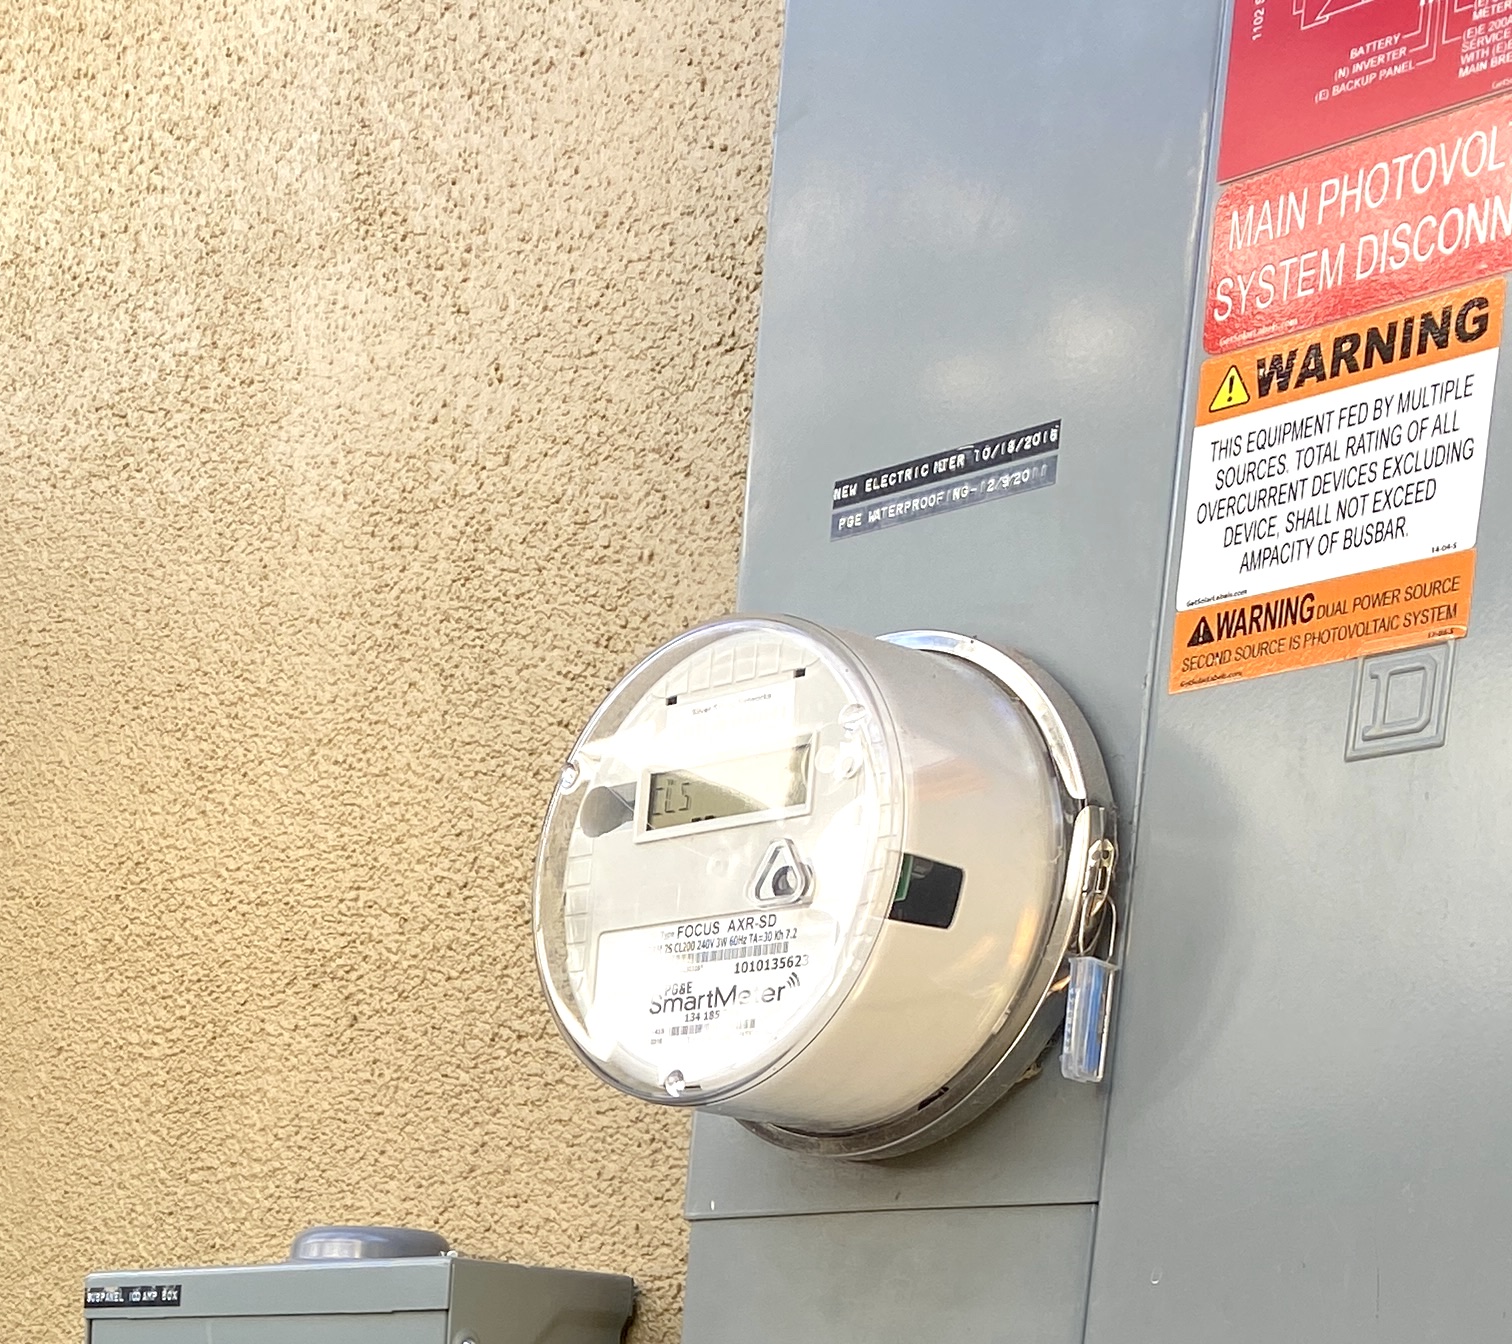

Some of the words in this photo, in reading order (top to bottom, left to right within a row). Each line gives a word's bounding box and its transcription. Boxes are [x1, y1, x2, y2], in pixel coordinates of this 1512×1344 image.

[1350, 33, 1400, 59] BATTERY
[1461, 47, 1489, 65] WITH
[1462, 28, 1511, 52] SERVICE
[1332, 74, 1376, 97] BACKUP
[1379, 61, 1415, 80] PANEL
[1335, 68, 1349, 82] (N)
[1352, 47, 1407, 74] INVERTER
[1458, 60, 1487, 78] MAIN
[1229, 188, 1308, 251] MAIN
[1318, 125, 1512, 225] PHOTOVOL
[1214, 243, 1344, 321] SYSTEM
[1257, 297, 1489, 398] WARNING
[1211, 436, 1241, 462] THIS
[1247, 412, 1335, 453] EQUIPMENT
[1338, 403, 1368, 427] FED
[1373, 395, 1394, 420] BY
[1397, 374, 1475, 415] MULTIPLE
[1216, 455, 1289, 490] SOURCES.
[1295, 440, 1340, 471] TOTAL
[1346, 425, 1402, 457] RATING
[1408, 417, 1429, 442] OF
[1432, 410, 1460, 436] ALL
[833, 483, 857, 501] NEW
[865, 463, 929, 492] ELECTRIC
[1197, 478, 1308, 524] OVERCURRENT
[1312, 462, 1377, 497] DEVICES
[1383, 438, 1474, 479] EXCLUDING
[839, 515, 862, 531] PGE
[1224, 516, 1279, 548] DEVICE,
[1286, 504, 1331, 532] SHALL
[1337, 494, 1369, 521] NOT
[1372, 479, 1436, 513] EXCEED
[1239, 540, 1313, 574] AMPACITY
[1318, 532, 1339, 555] OF
[1343, 516, 1408, 551] BUSBAR.
[1217, 592, 1315, 640] WARNING
[1316, 602, 1349, 620] DUAL
[1352, 589, 1401, 613] POWER
[1404, 575, 1462, 602] SOURCE
[1182, 651, 1232, 673] SECOND
[1234, 641, 1286, 663] SOURCE
[1289, 635, 1301, 650] IS
[1304, 615, 1399, 649] PHOTOVOLTAIC
[1403, 603, 1458, 627] SYSTEM
[674, 941, 695, 953] CL200
[697, 938, 714, 951] 240V
[717, 937, 727, 948] 3W
[729, 936, 747, 947] 60Hz
[749, 931, 772, 944] TA=30
[775, 930, 784, 940] Kh
[677, 921, 720, 938] FOCUS
[728, 914, 777, 932] AXR-SD
[734, 954, 809, 974] 1010135623
[649, 985, 786, 1014] SmartMeer
[665, 982, 693, 996] PG&E
[685, 1012, 700, 1022] 134
[704, 1010, 720, 1020] 185
[142, 1291, 157, 1301] AMP
[161, 1289, 178, 1300] BOX
